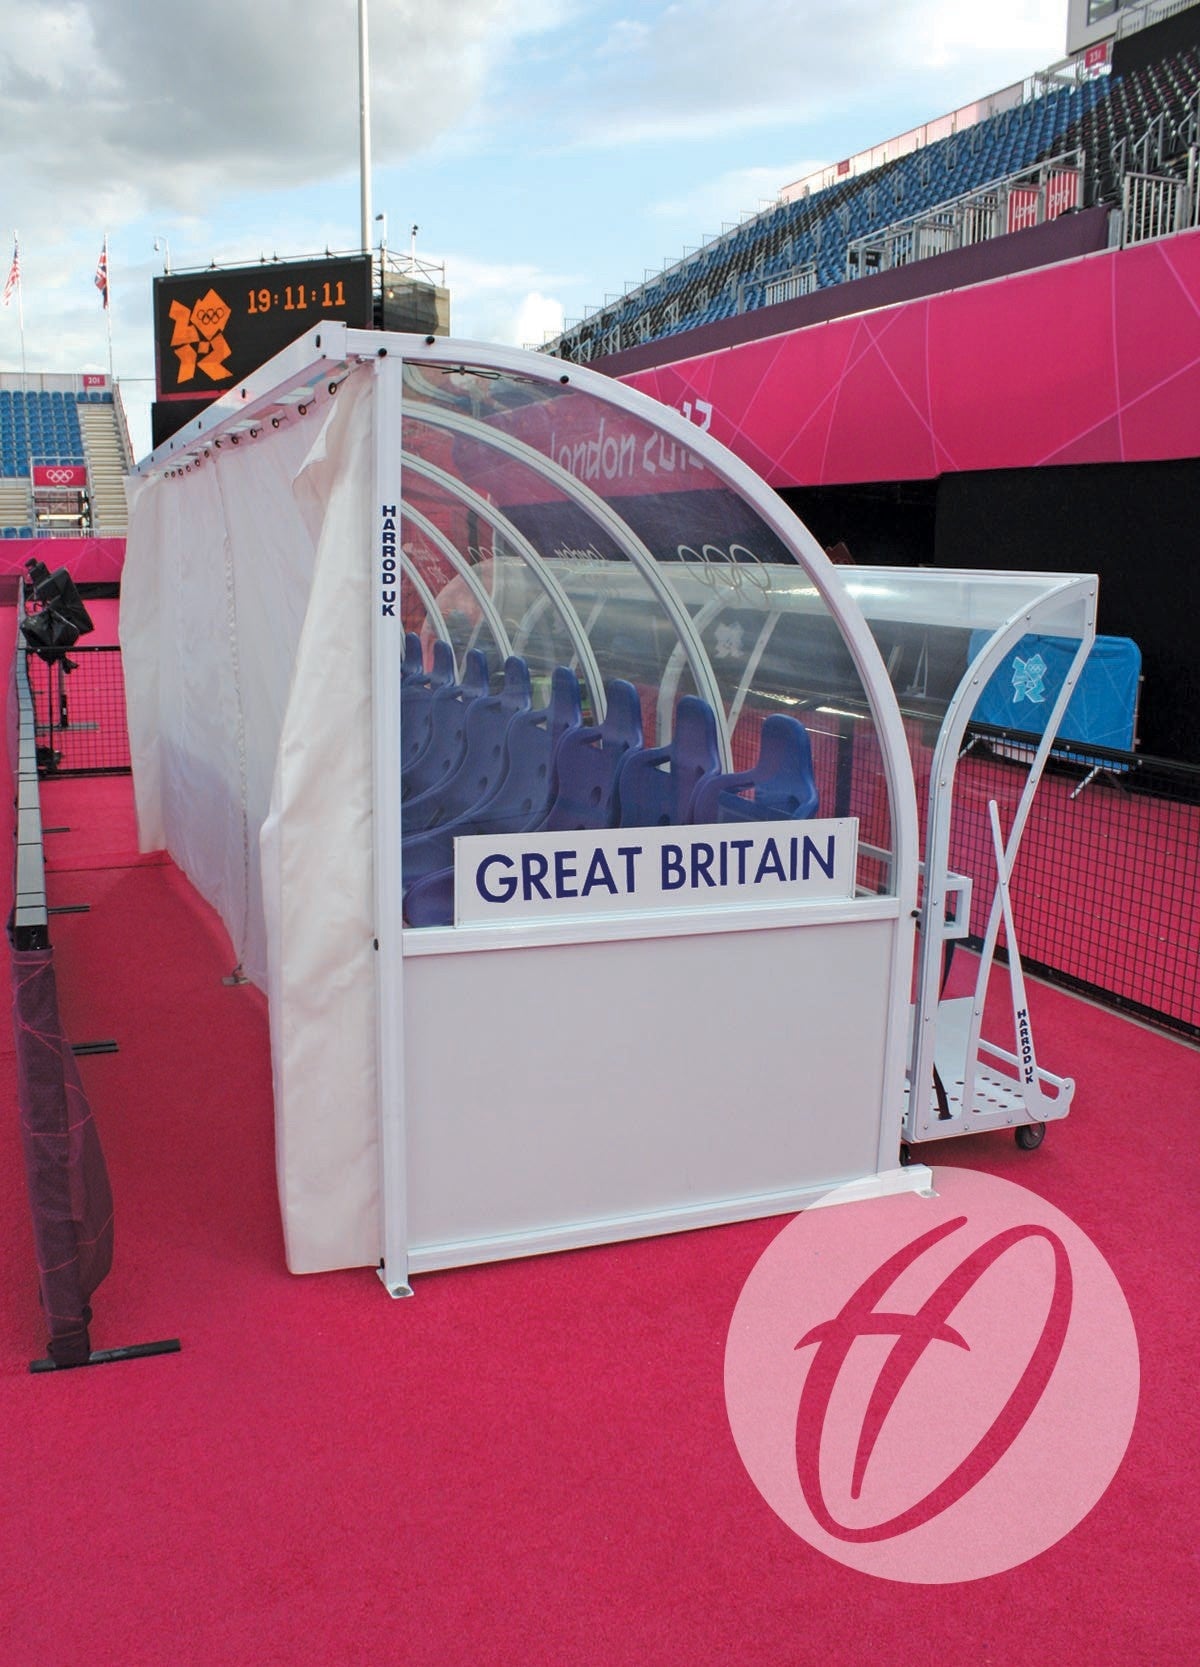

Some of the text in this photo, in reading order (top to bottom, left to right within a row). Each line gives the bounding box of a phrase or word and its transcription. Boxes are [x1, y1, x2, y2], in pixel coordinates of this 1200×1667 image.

[382, 505, 396, 616] HARROD UK
[475, 835, 836, 903] GREAT BRITAIN
[1017, 1009, 1034, 1084] HARROD UK
